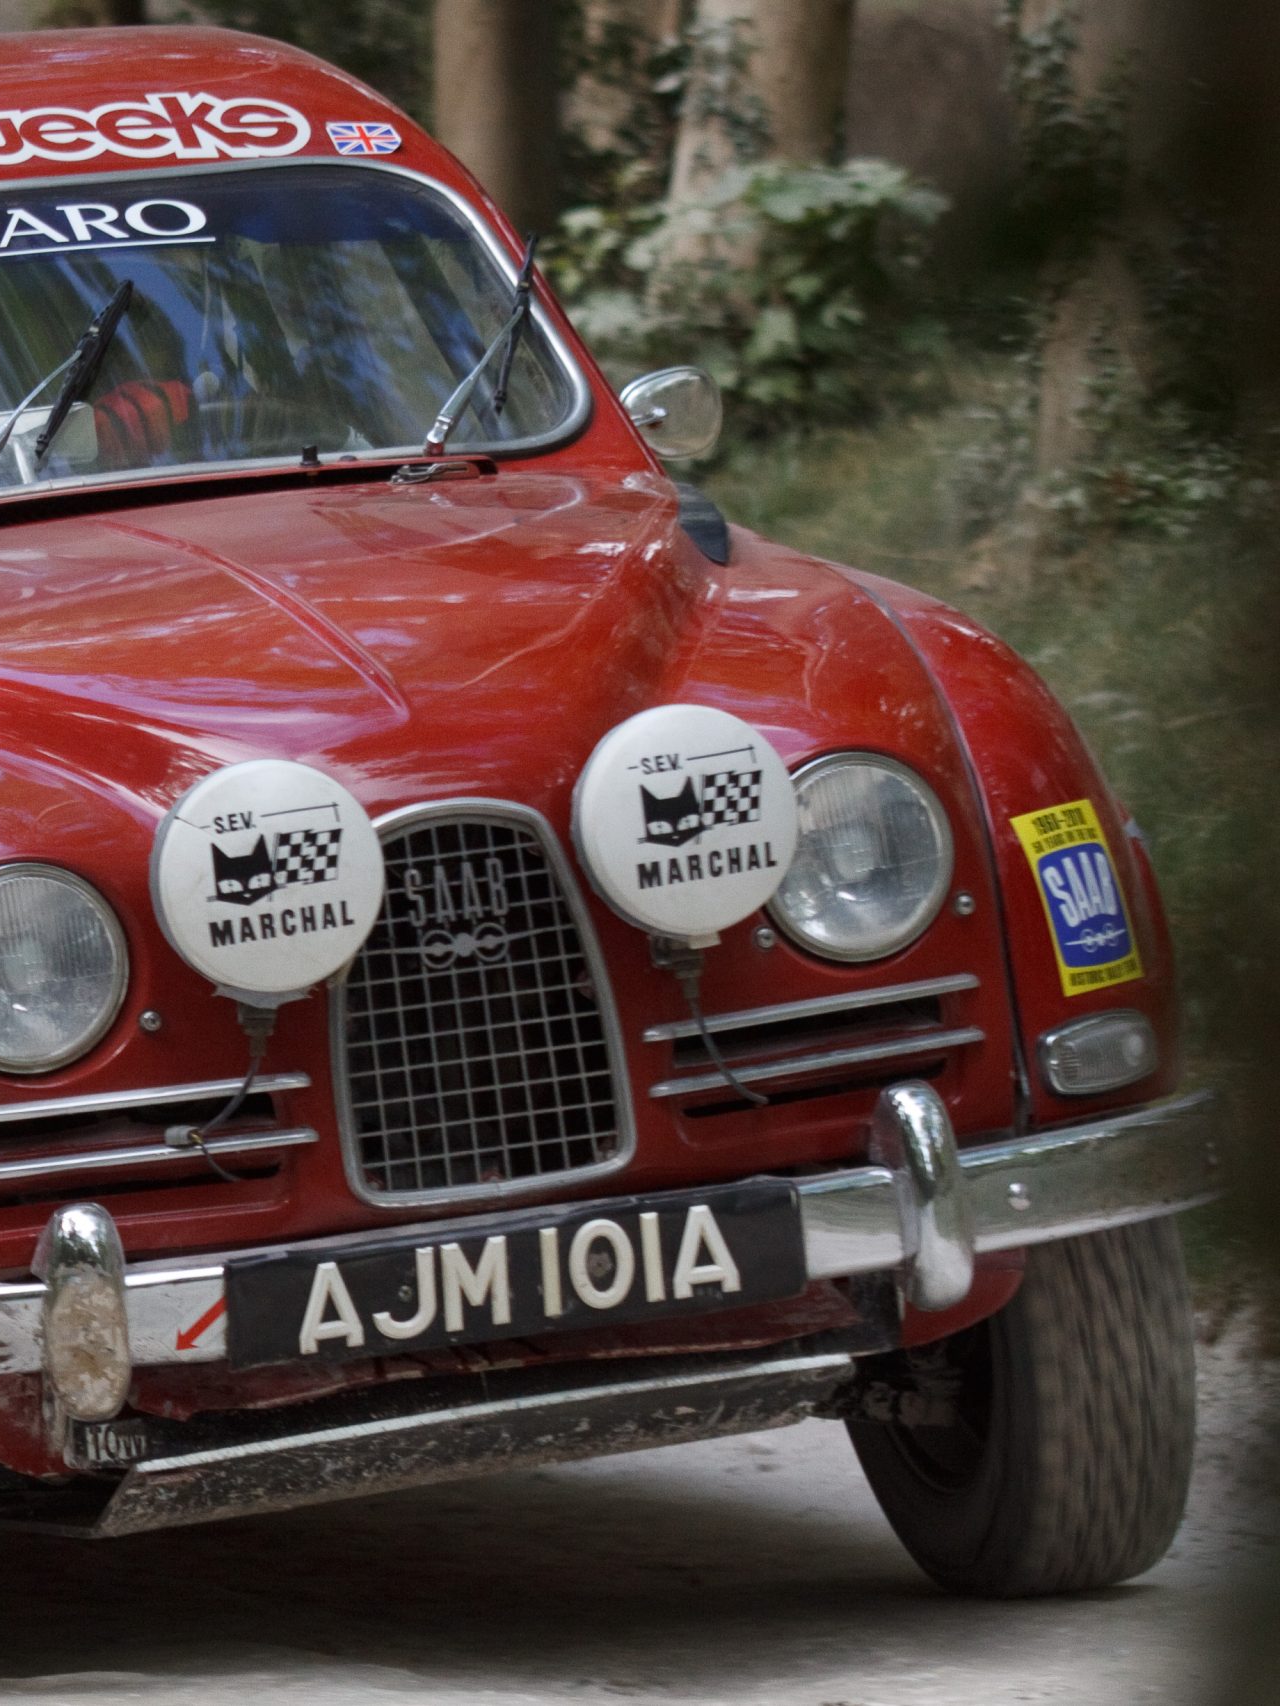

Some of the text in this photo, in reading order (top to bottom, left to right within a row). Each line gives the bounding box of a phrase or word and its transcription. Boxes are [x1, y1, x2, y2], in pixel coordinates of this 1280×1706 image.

[404, 857, 510, 929] SAAB
[637, 842, 778, 890] MARCHAL
[1042, 852, 1118, 927] SAAB
[209, 900, 356, 948] MARCHAL
[299, 1204, 742, 1356] AJM 101A
